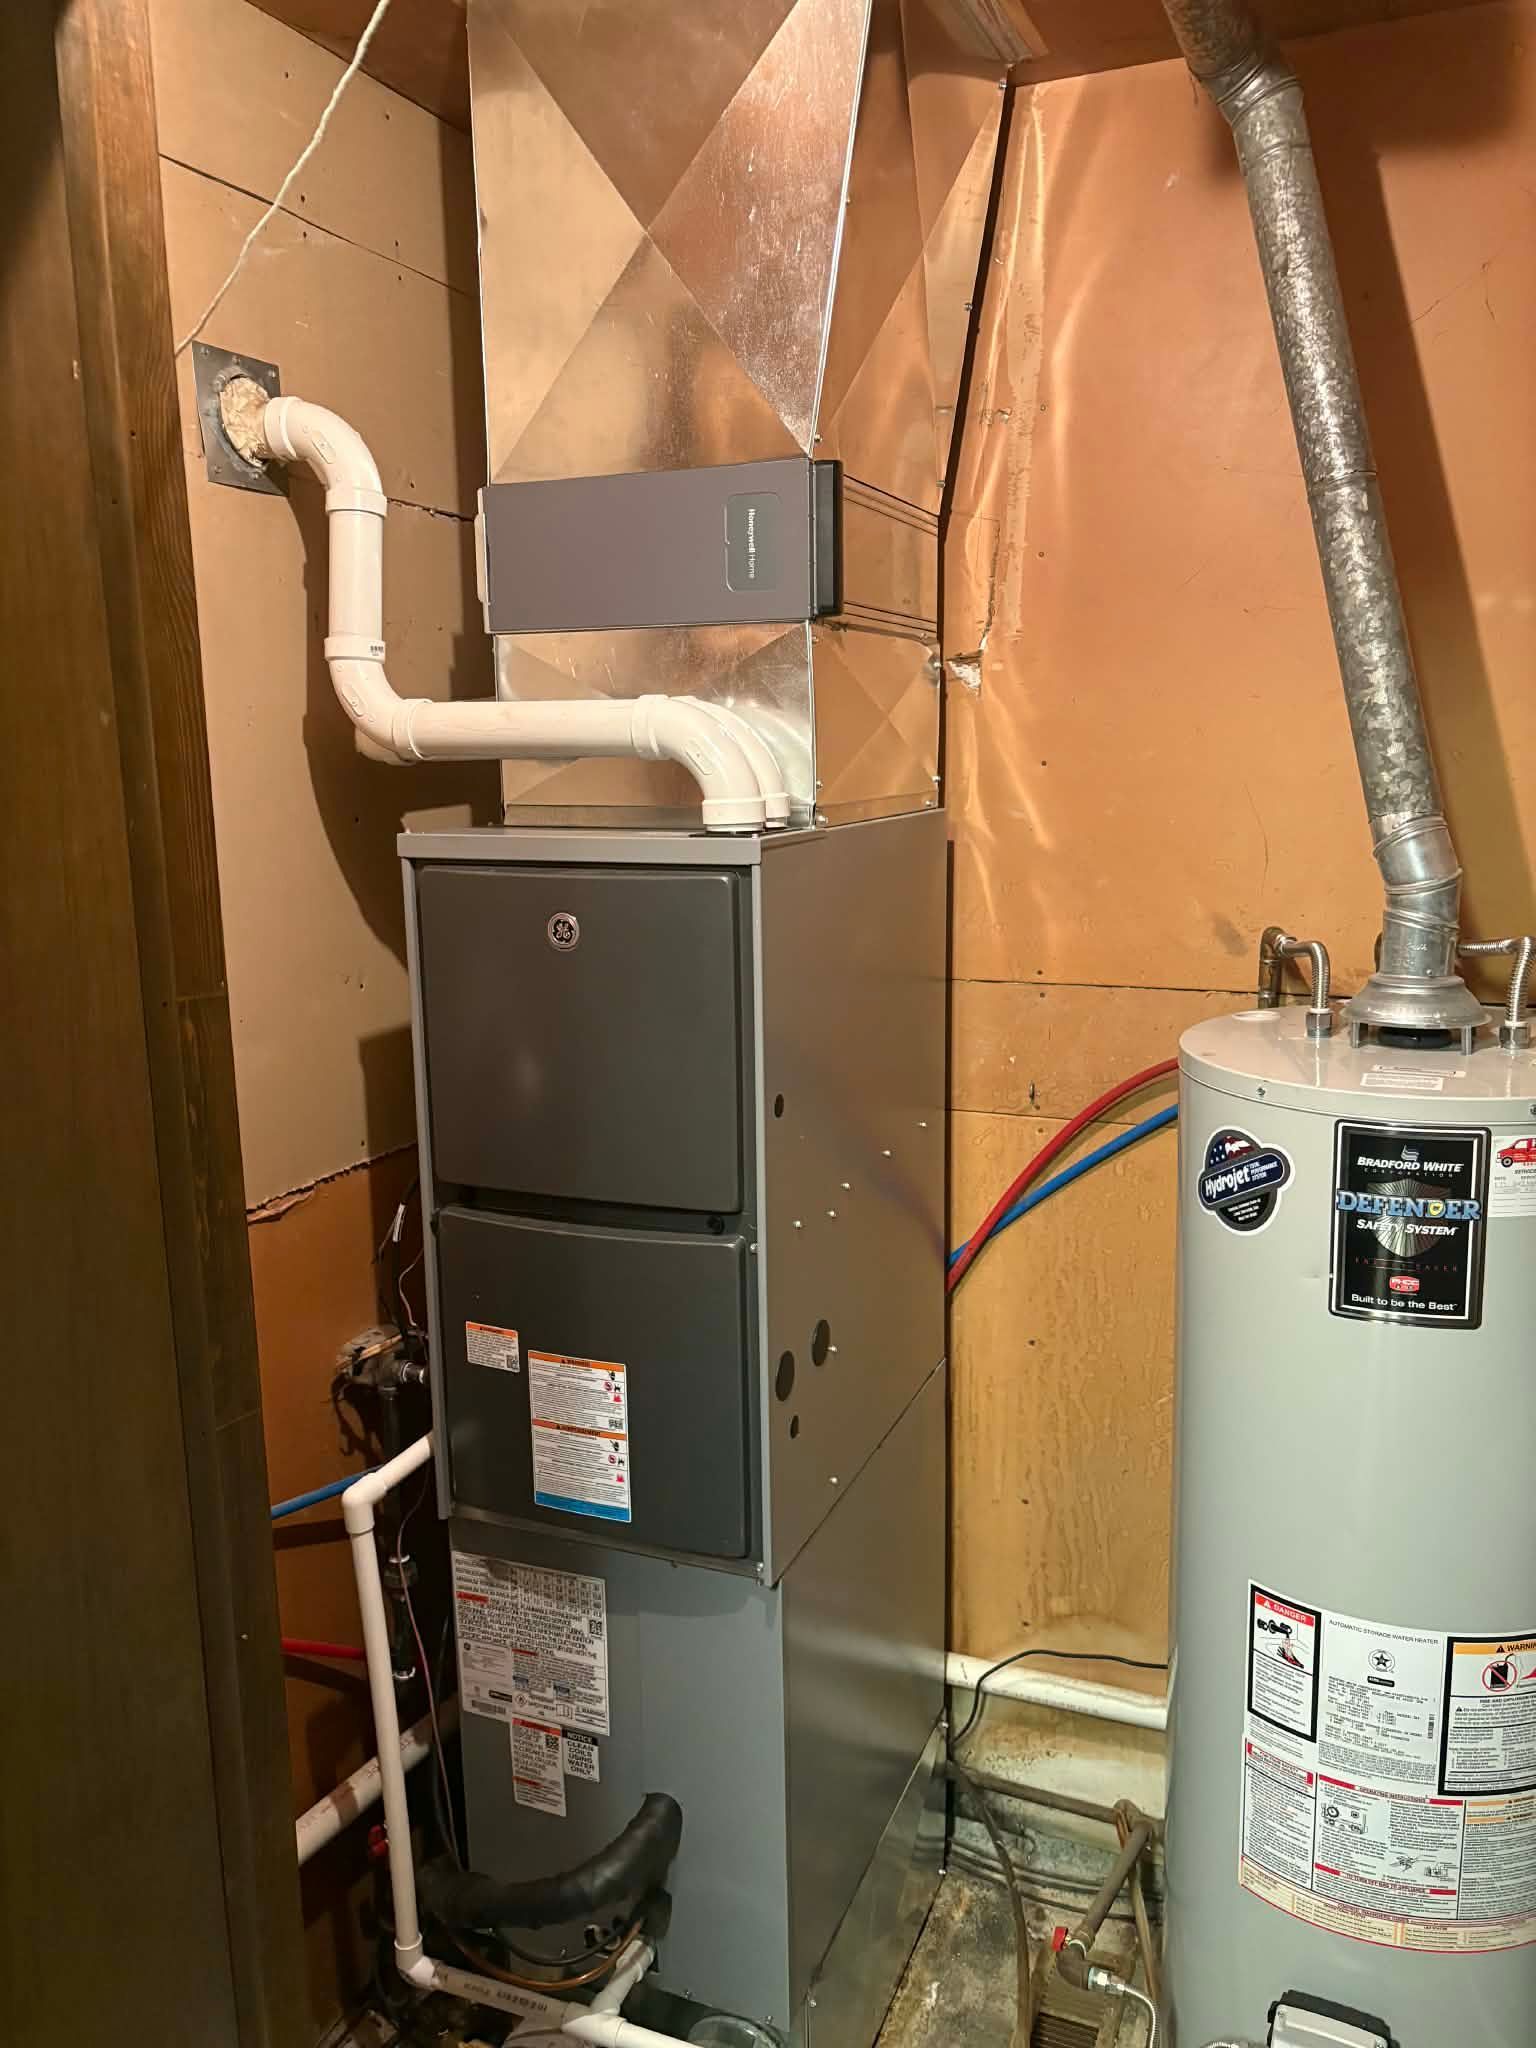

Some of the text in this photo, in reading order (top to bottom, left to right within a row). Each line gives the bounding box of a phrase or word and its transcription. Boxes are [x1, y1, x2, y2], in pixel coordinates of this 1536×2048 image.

[748, 508, 756, 552] Honeywell
[1357, 1156, 1462, 1173] BRADFORD WHITE
[1204, 1164, 1251, 1199] Hydrojet
[1337, 1189, 1481, 1220] DEFENDER
[1356, 1219, 1456, 1236] SAFETY SYSTEM
[1351, 1294, 1374, 1304] Built
[1376, 1297, 1388, 1306] to
[1390, 1299, 1405, 1308] be
[1408, 1300, 1425, 1309] the
[1273, 1603, 1307, 1623] DANGER
[1328, 1619, 1439, 1645] AUTOMATIC STORAGE WATER HEATER
[567, 1731, 593, 1743] NOTICE
[568, 1741, 594, 1751] CLEAN
[569, 1748, 593, 1757] COILS
[568, 1759, 595, 1770] WATER
[569, 1753, 593, 1763] USING
